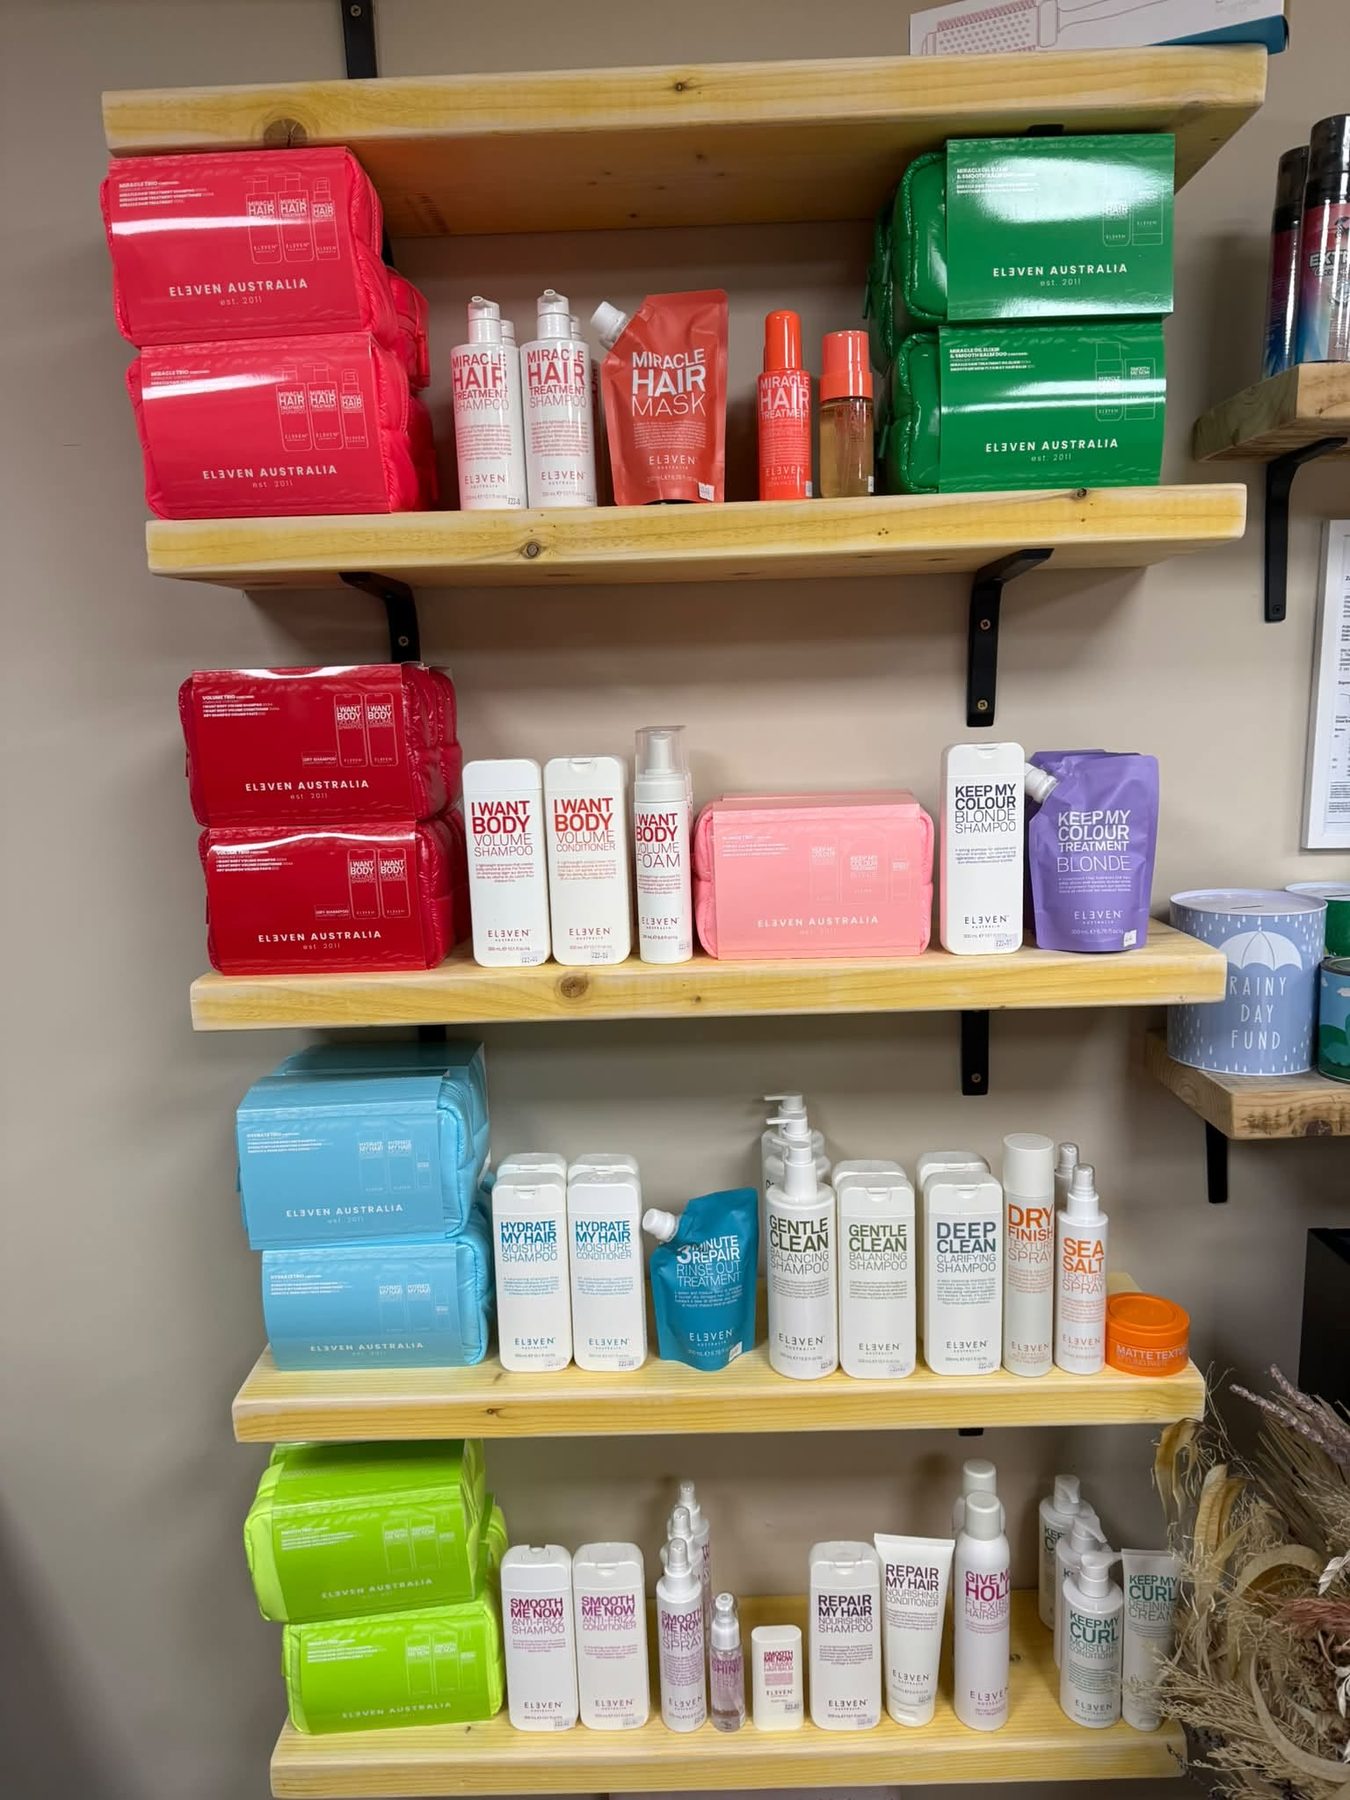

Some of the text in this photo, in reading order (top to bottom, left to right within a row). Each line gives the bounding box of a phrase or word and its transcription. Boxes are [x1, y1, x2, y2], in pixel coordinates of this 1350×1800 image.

[249, 204, 275, 216] HAIR
[280, 202, 307, 214] HAIR
[1050, 263, 1128, 276] AUSTRALIA
[228, 278, 308, 293] AUSTRALIA
[1062, 278, 1081, 286] 2011
[242, 296, 262, 305] 2011
[452, 351, 506, 368] MIRACLE
[527, 349, 584, 363] MIRACLE
[632, 348, 705, 369] MIRACLE
[453, 367, 507, 392] HAIR
[528, 362, 585, 387] HAIR
[632, 366, 706, 397] HAIR
[761, 376, 809, 389] MIRACLE
[453, 389, 508, 401] TREATMENT
[529, 384, 585, 396] TREATMENT
[279, 395, 305, 407] HAIR
[310, 393, 336, 405] HAIR
[529, 395, 587, 409] SHAMPOO
[632, 394, 706, 417] MASK
[760, 388, 809, 410] HAIR
[761, 408, 809, 420] TREATMENT
[1042, 438, 1118, 451] AUSTRALIA
[1053, 453, 1071, 461] 2011
[260, 464, 337, 477] AUSTRALIA
[340, 705, 361, 713] WANT
[371, 704, 391, 712] WANT
[337, 711, 362, 721] BODY
[368, 711, 392, 720] BODY
[298, 779, 369, 789] AUSTRALIA
[955, 784, 1017, 798] KEEP MY
[471, 800, 530, 816] I WANT
[554, 797, 613, 813] I WANT
[955, 796, 1016, 811] COLOUR
[555, 813, 613, 832] BODY
[639, 813, 678, 827] WANT
[955, 808, 1016, 824] BLONDE
[1058, 810, 1131, 827] KEEP MY
[473, 815, 530, 834] BODY
[955, 821, 1017, 834] SHAMPOO
[474, 833, 532, 846] VOLUME
[556, 830, 615, 844] VOLUME
[636, 826, 678, 843] BODY
[1058, 825, 1129, 841] COLOUR
[474, 845, 533, 857] SHAMPOO
[556, 842, 616, 852] CONDITIONER
[637, 842, 679, 855] VOLUME
[1058, 841, 1130, 853] TREATMENT
[637, 853, 681, 868] FOAM
[1057, 856, 1132, 873] BLONDE
[350, 866, 375, 875] BODY
[380, 865, 405, 874] BODY
[808, 916, 879, 926] AUSTRALIA
[311, 930, 381, 940] AUSTRALIA
[1230, 976, 1287, 996] RAINY
[1240, 1004, 1275, 1023] DAY
[1231, 1030, 1281, 1050] FUND
[335, 1204, 404, 1215] AUSTRALIA
[1008, 1204, 1054, 1229] DRY
[500, 1220, 556, 1233] HYDRATE
[575, 1220, 630, 1233] HYDRATE
[769, 1215, 828, 1235] GENTLE
[848, 1224, 907, 1237] GENTLE
[936, 1222, 996, 1239] DEEP
[501, 1231, 557, 1243] MY HAIR
[575, 1231, 631, 1243] MY HAIR
[1008, 1226, 1053, 1242] FINISH
[502, 1242, 558, 1253] MOISTURE
[576, 1242, 631, 1253] MOISTURE
[770, 1230, 829, 1252] CLEAN
[849, 1237, 907, 1252] CLEAN
[937, 1239, 996, 1254] CLEAN
[676, 1235, 739, 1264] 3 MINUTE
[1063, 1237, 1104, 1259] SEA
[502, 1252, 558, 1262] SHAMPOO
[576, 1251, 632, 1261] CONDITIONER
[691, 1248, 740, 1264] REPAIR
[770, 1249, 829, 1264] BALANCING
[849, 1252, 907, 1262] BALANCING
[936, 1253, 997, 1263] CLARIFYING
[676, 1261, 740, 1276] RINSE OUT
[770, 1258, 829, 1275] SHAMPOO
[849, 1261, 907, 1271] SHAMPOO
[936, 1262, 996, 1273] SHAMPOO
[1063, 1257, 1104, 1275] SALT
[677, 1272, 741, 1287] TREATMENT
[359, 1342, 424, 1351] AUSTRALIA
[1116, 1345, 1153, 1360] MATTE
[886, 1564, 939, 1580] REPAIR
[965, 1570, 998, 1586] GIVE
[369, 1578, 433, 1592] AUSTRALIA
[886, 1577, 939, 1591] MY HAIR
[1129, 1575, 1178, 1587] KEEP MY
[819, 1594, 872, 1606] REPAIR
[886, 1589, 939, 1600] NOURISHING
[1129, 1585, 1176, 1602] CURL
[510, 1598, 563, 1609] SMOOTH
[582, 1594, 635, 1607] SMOOTH
[886, 1597, 939, 1608] CONDITIONER
[511, 1607, 564, 1618] ME NOW
[582, 1605, 635, 1616] ME NOW
[819, 1606, 872, 1617] MY HAIR
[511, 1617, 565, 1626] ANTI-FRIZZ
[583, 1615, 636, 1624] ANTI-FRIZZ
[818, 1616, 873, 1625] NOURISHING
[1070, 1610, 1120, 1628] KEEP MY
[511, 1624, 565, 1635] SHAMPOO
[583, 1622, 637, 1631] CONDITIONER
[818, 1624, 873, 1634] SHAMPOO
[1070, 1622, 1119, 1644] CURL
[764, 1650, 793, 1658] SMOOTH
[389, 1702, 452, 1714] AUSTRALIA
